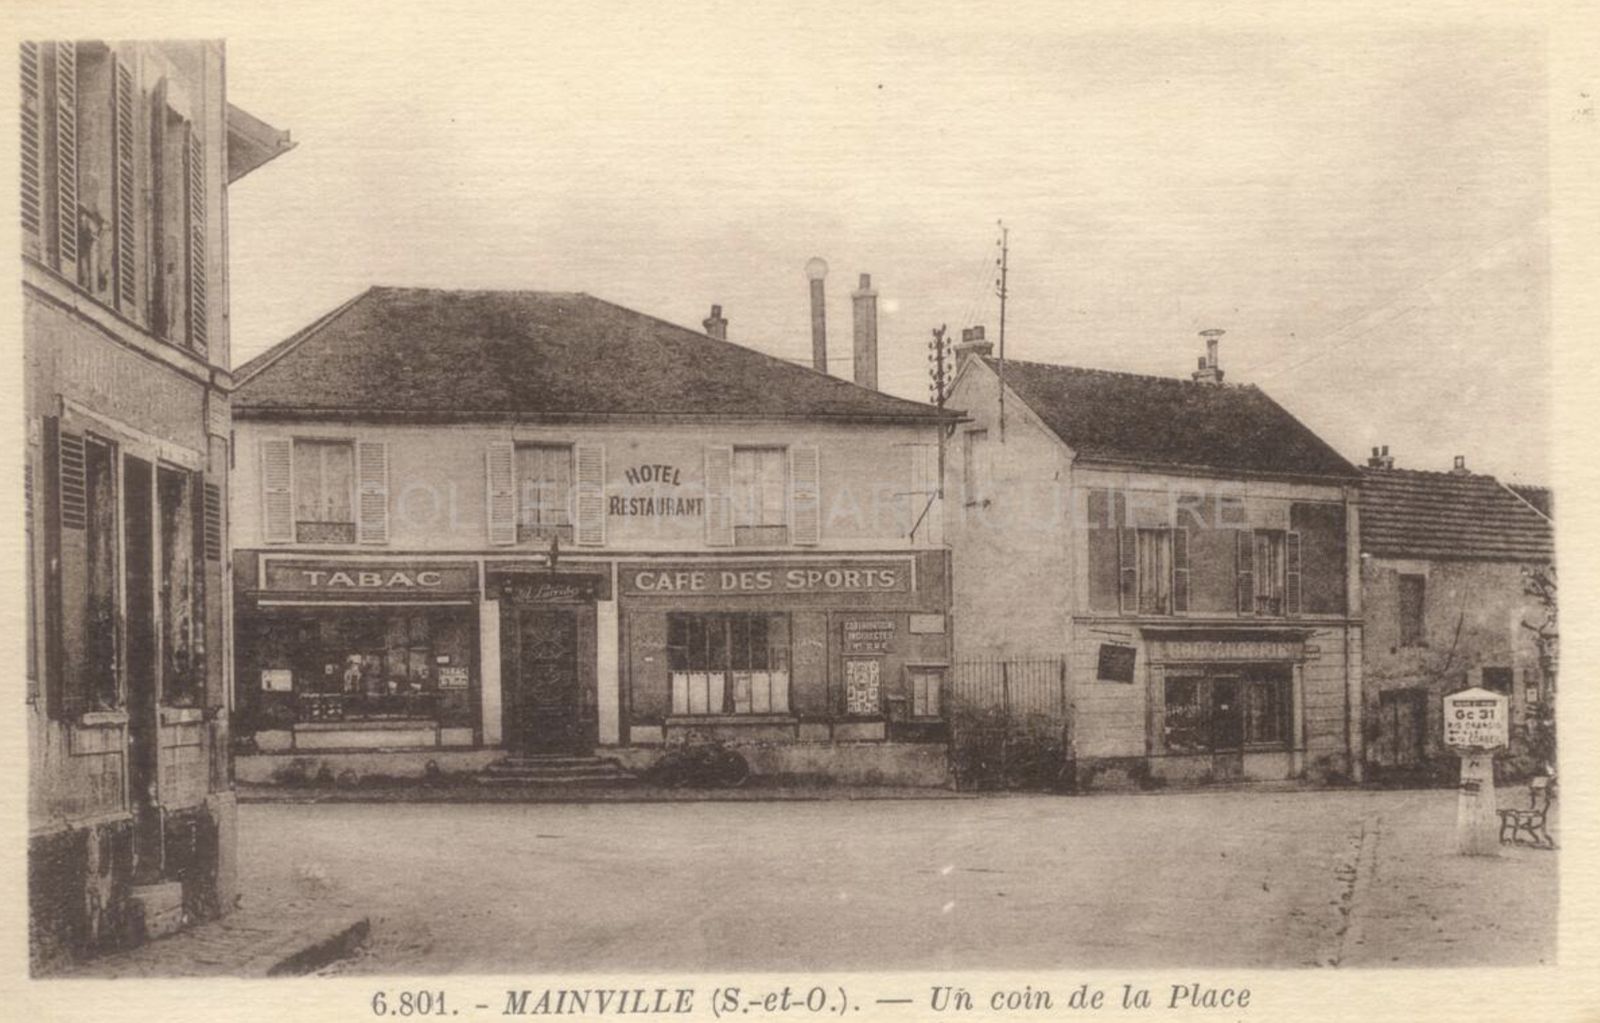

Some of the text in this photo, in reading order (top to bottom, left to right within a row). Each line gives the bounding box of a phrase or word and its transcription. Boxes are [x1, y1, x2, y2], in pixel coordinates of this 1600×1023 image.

[625, 463, 682, 487] HOTEL
[608, 495, 705, 517] RESTAURANT
[302, 570, 443, 588] TABAC
[721, 571, 773, 590] DES
[786, 569, 897, 589] SPORTS
[1479, 708, 1495, 720] 31
